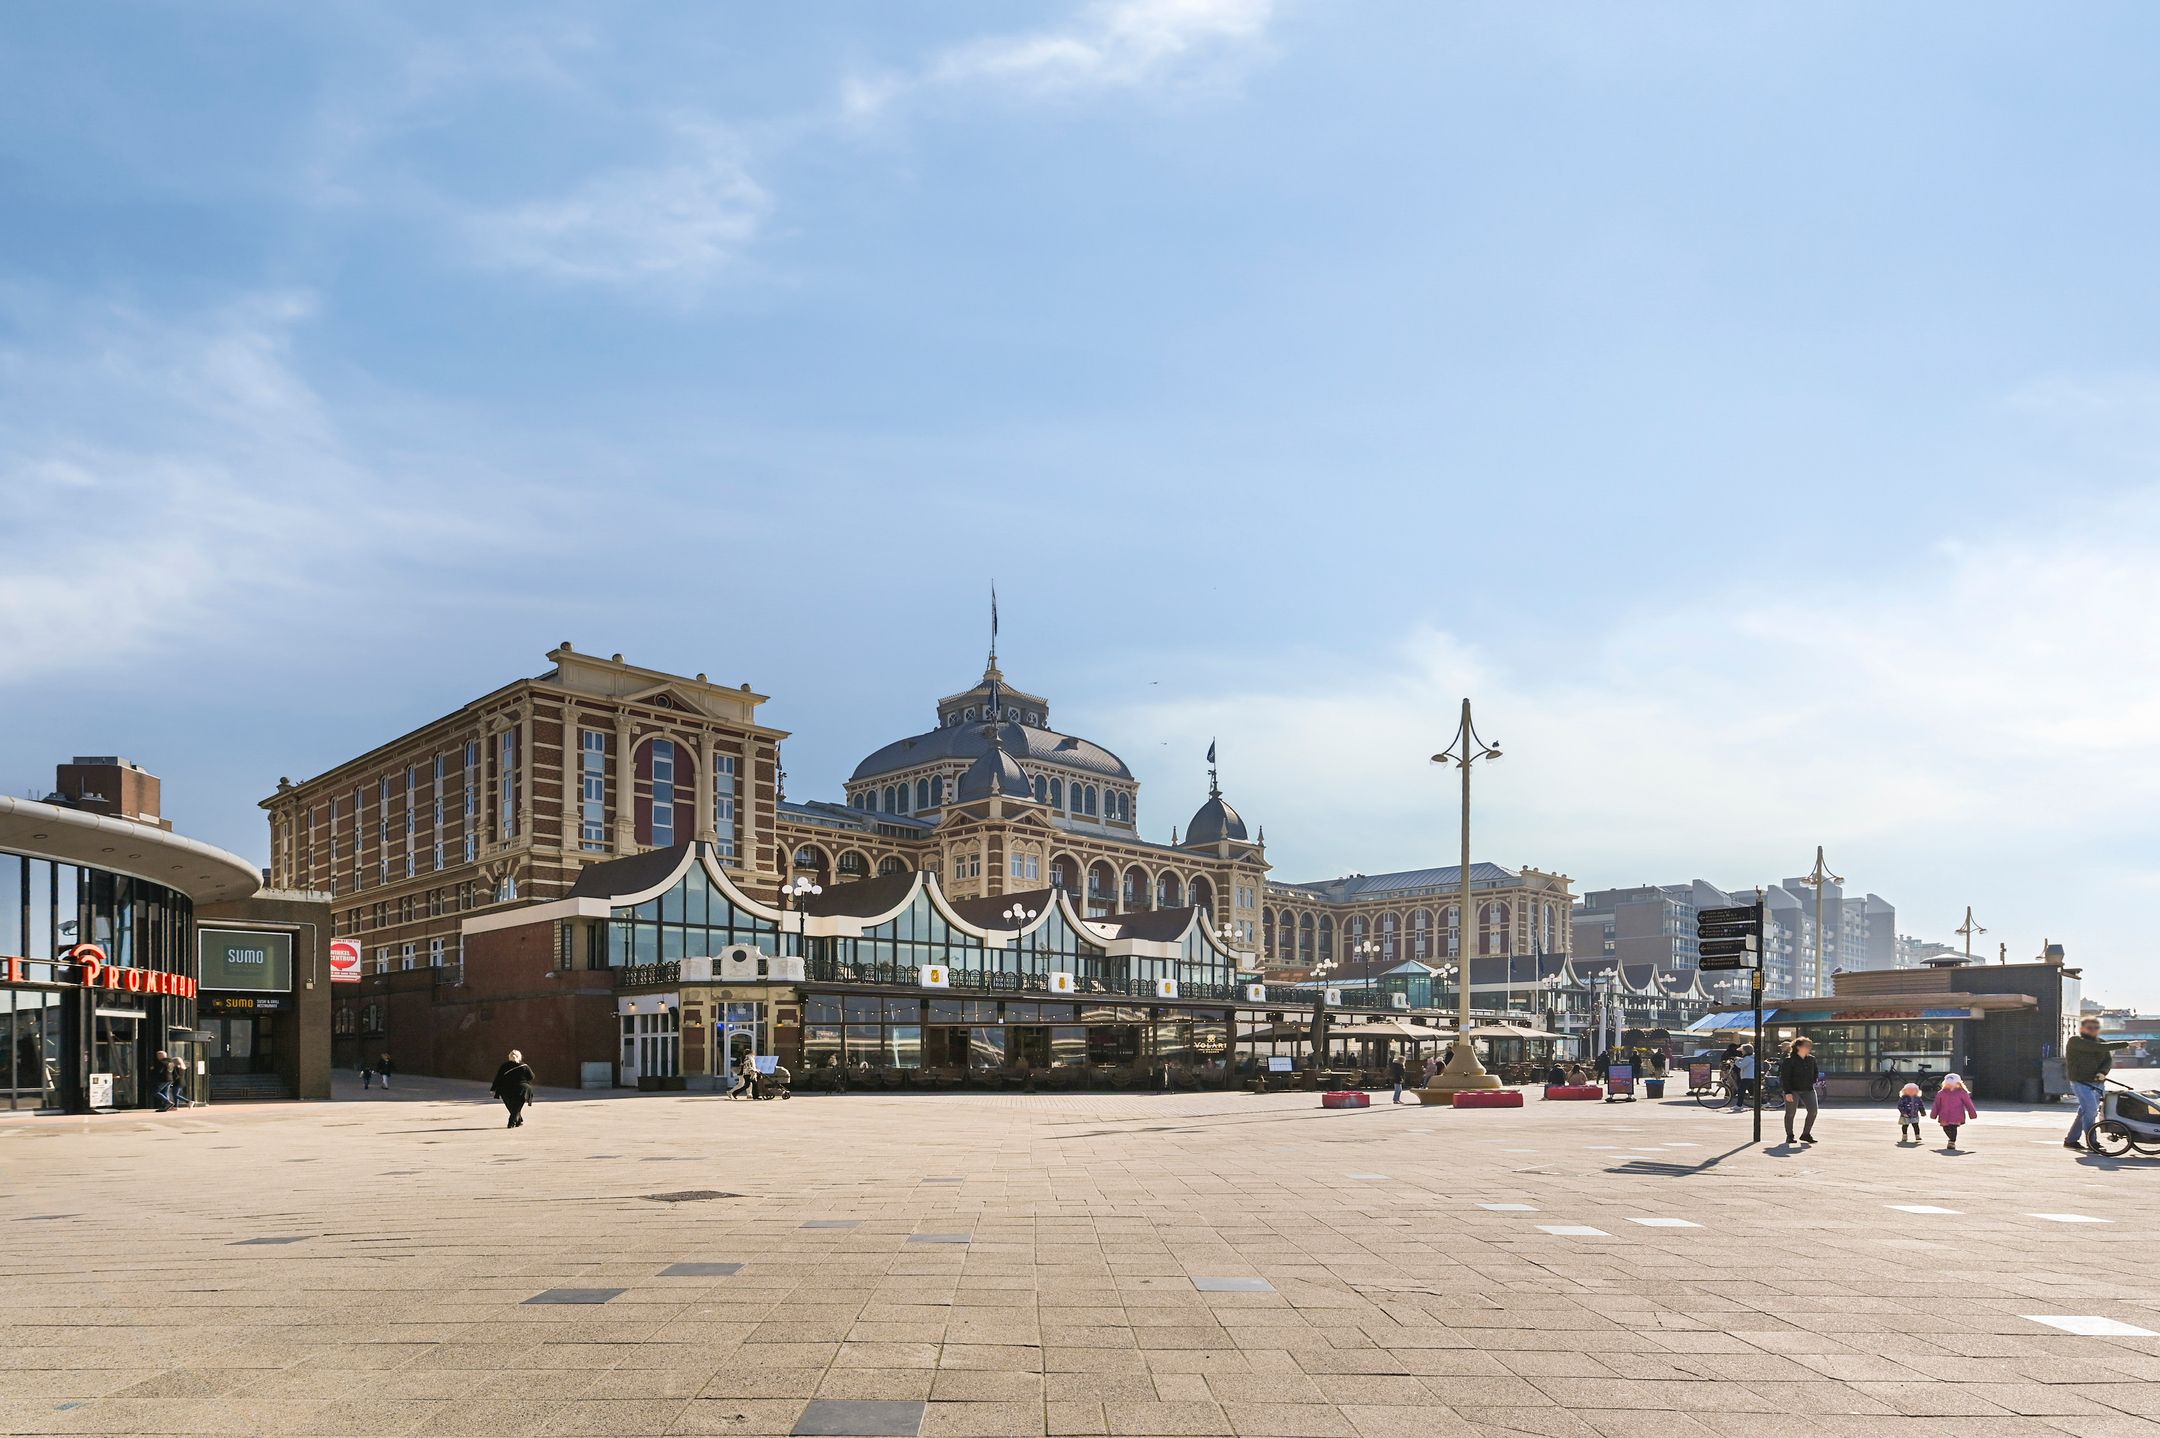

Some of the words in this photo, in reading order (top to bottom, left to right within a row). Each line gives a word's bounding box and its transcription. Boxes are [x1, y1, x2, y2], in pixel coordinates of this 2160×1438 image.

[228, 949, 263, 964] SUMO
[80, 953, 197, 998] PROMENADE
[226, 998, 254, 1008] SUMO
